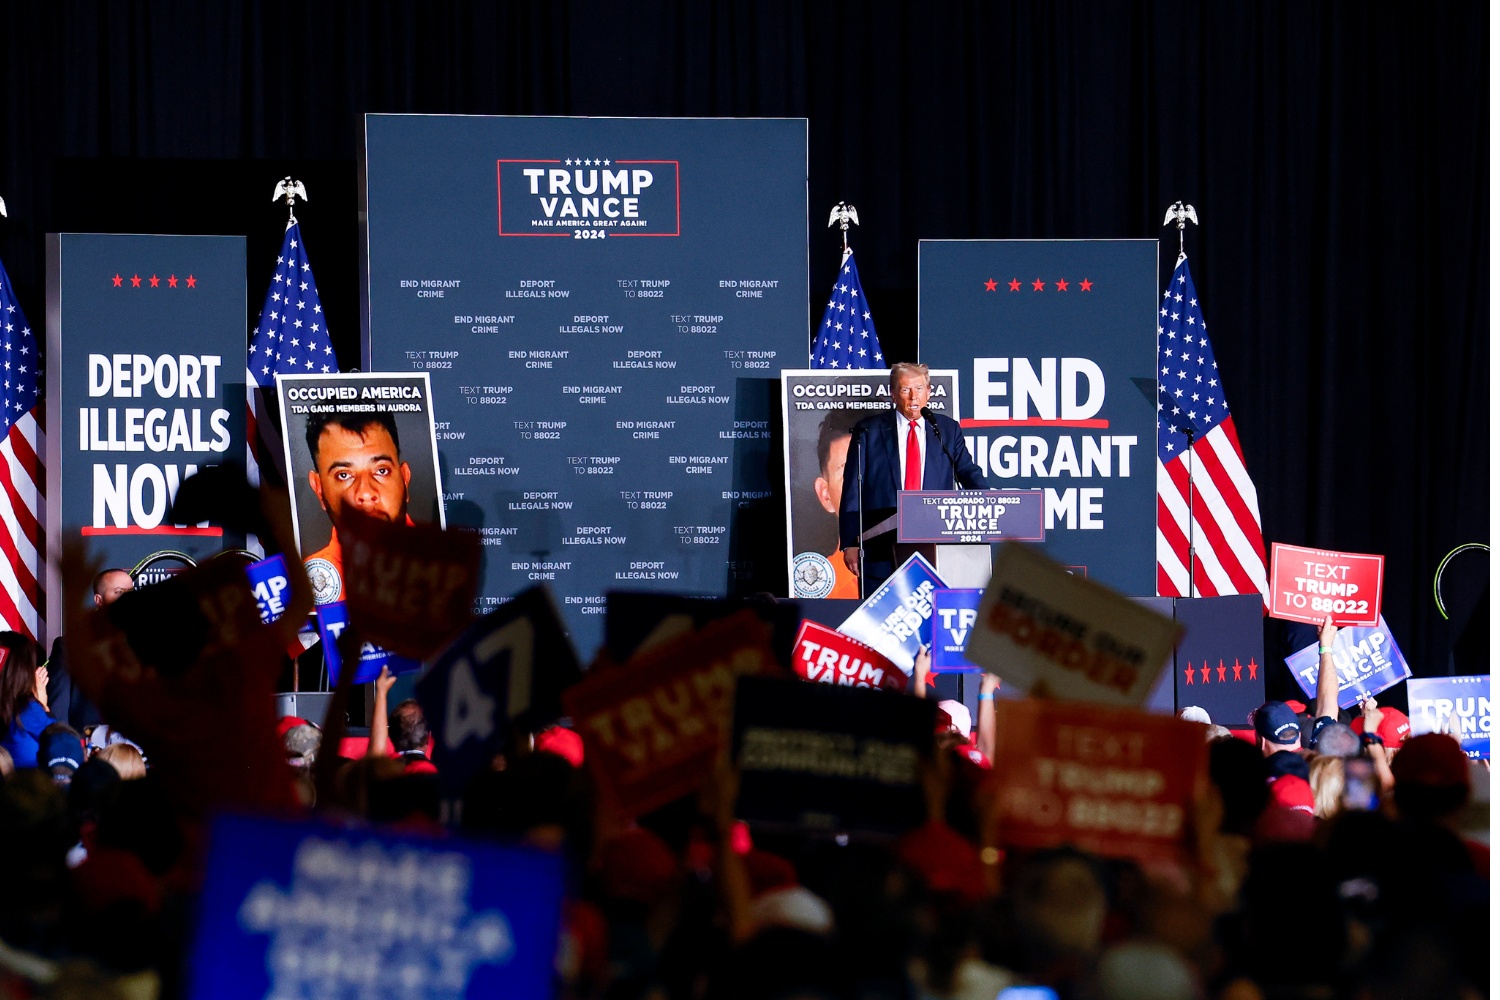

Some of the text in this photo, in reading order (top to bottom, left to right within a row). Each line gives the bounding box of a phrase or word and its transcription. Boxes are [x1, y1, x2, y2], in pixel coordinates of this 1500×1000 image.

[523, 169, 654, 194] TRUMP
[540, 198, 639, 217] VANCE
[574, 230, 606, 239] 2024
[401, 280, 461, 288] END MIGRANT
[520, 280, 555, 288] DEPORT
[617, 280, 670, 288] TEXT TRUMP
[417, 290, 444, 298] CRIME
[506, 290, 570, 298] ILLEGALS NOW
[624, 290, 663, 298] TO 88022
[671, 315, 723, 323] TEXT TRUMP
[405, 351, 459, 359] TEXT TRUMP
[412, 361, 452, 369] TO 88022
[89, 354, 221, 398] DEPORT
[288, 386, 421, 400] OCCUPIED AMERICA
[793, 384, 871, 397] OCCUPIED
[974, 357, 1106, 420] END
[291, 403, 421, 413] TDA GANG MEMBERS IN AURORA
[795, 402, 815, 410] TDA
[817, 401, 843, 410] GANG
[846, 401, 891, 409] MEMBERS
[79, 407, 231, 452] ILLEGALS
[937, 505, 1005, 519] TRUMP
[945, 519, 997, 530] VANCE
[1303, 561, 1350, 580] TEXT
[1294, 577, 1359, 597] TRUMP
[905, 580, 935, 608] OUR
[1283, 591, 1368, 614] TO 88022
[1299, 631, 1386, 685] TUMP
[1337, 650, 1385, 685] ANCE
[445, 616, 534, 750] 47
[1396, 723, 1409, 735] USA
